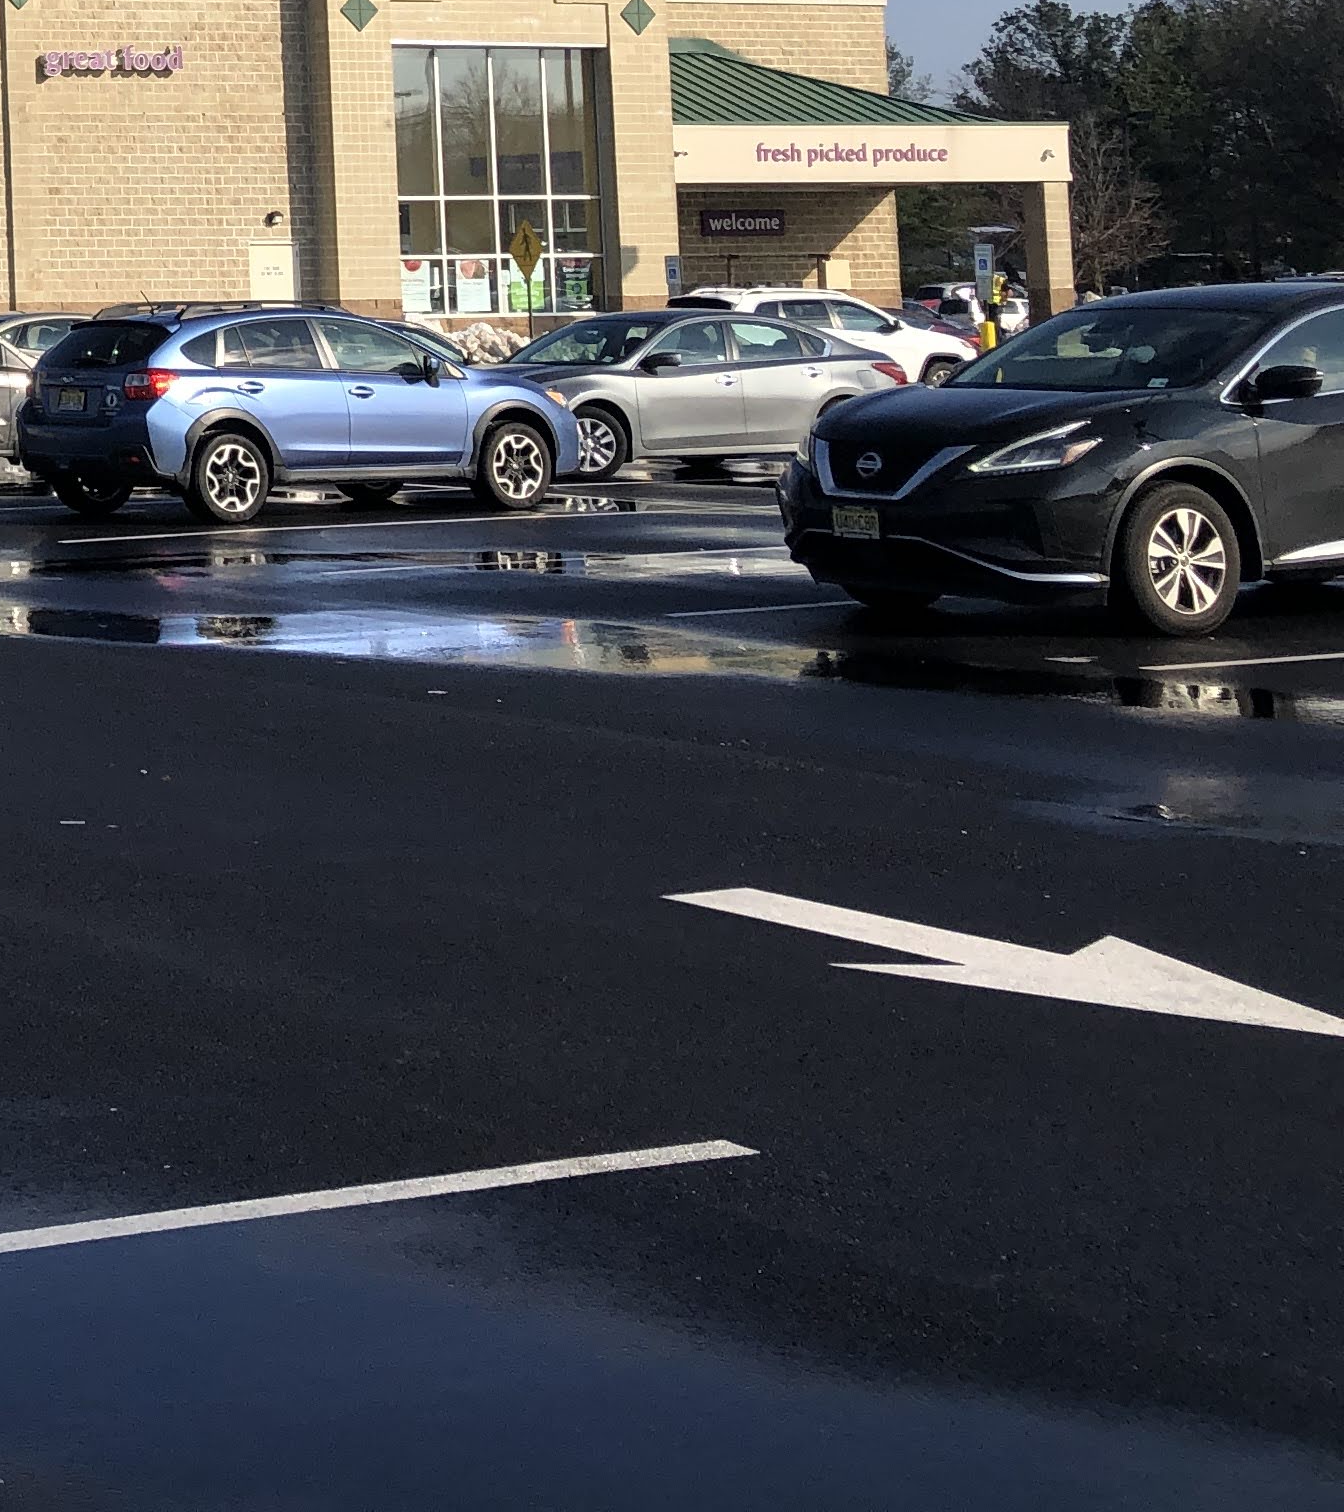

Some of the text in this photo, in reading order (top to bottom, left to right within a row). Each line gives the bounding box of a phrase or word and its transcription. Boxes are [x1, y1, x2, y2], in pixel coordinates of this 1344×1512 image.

[45, 44, 184, 76] great food
[756, 142, 948, 167] fresh picked produce
[709, 213, 780, 231] welcome
